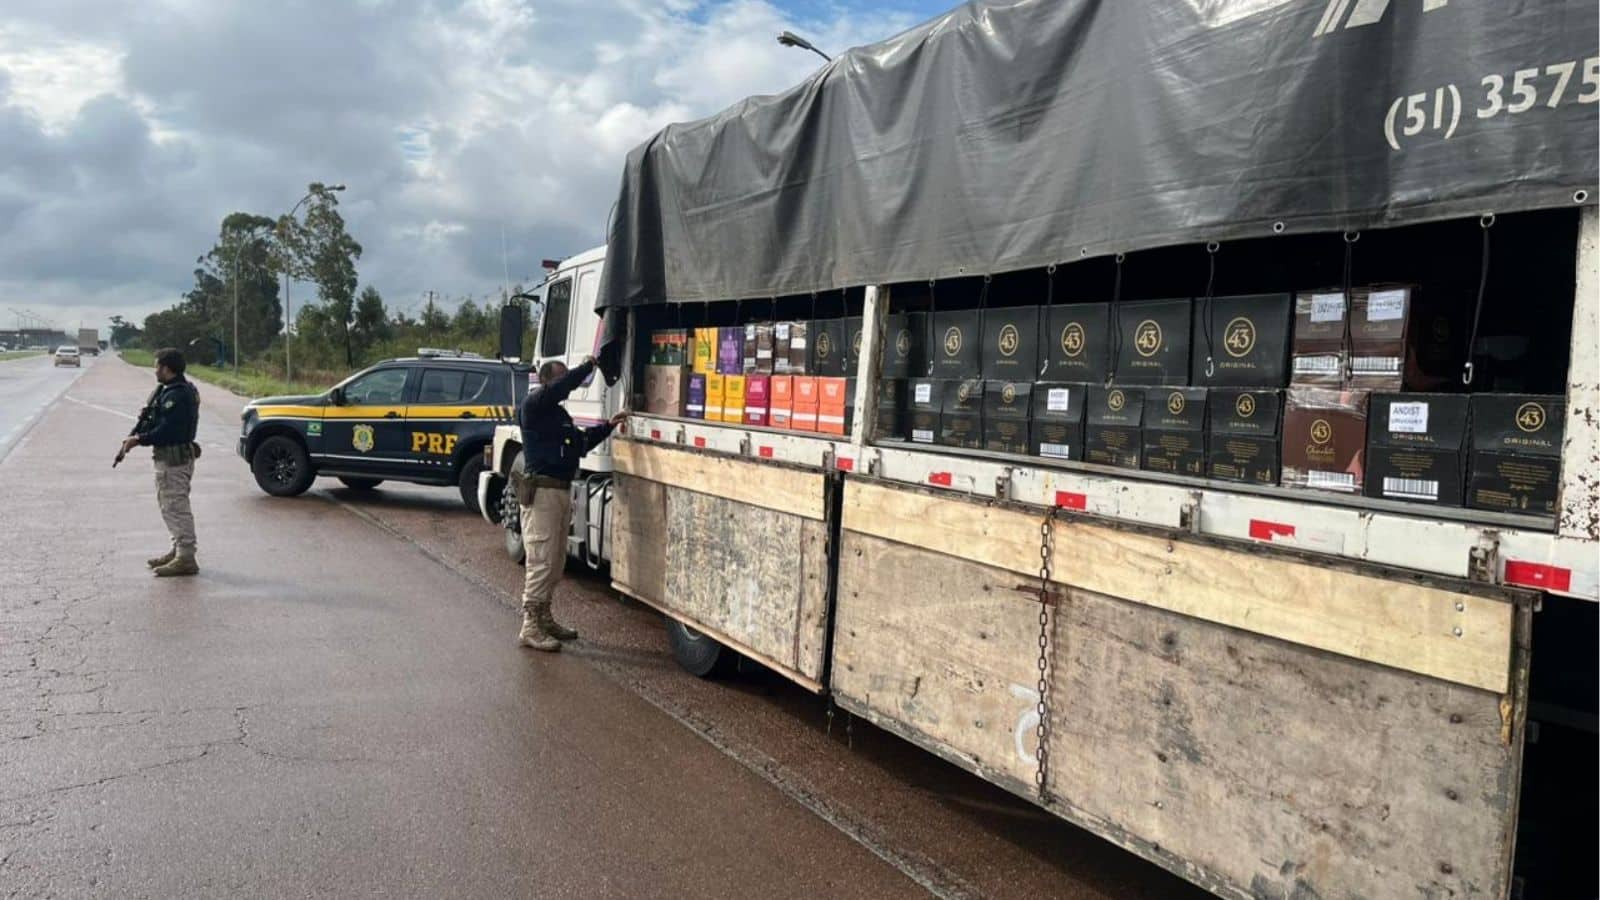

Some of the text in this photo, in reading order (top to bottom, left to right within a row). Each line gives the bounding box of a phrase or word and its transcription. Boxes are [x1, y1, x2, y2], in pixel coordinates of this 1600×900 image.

[1384, 56, 1600, 150] (51) 3575
[945, 335, 959, 350] 43
[1000, 334, 1015, 349] 43
[1064, 332, 1080, 348] 43
[1138, 330, 1157, 348] 43
[1228, 330, 1250, 348] 43
[1220, 361, 1256, 369] ORIGINAL
[1238, 400, 1251, 413] 43
[1519, 410, 1541, 427] 43
[1313, 424, 1328, 438] 43
[1392, 433, 1435, 443] ORIGINAL
[411, 431, 458, 455] PRF
[1503, 437, 1553, 447] ORIGINAL
